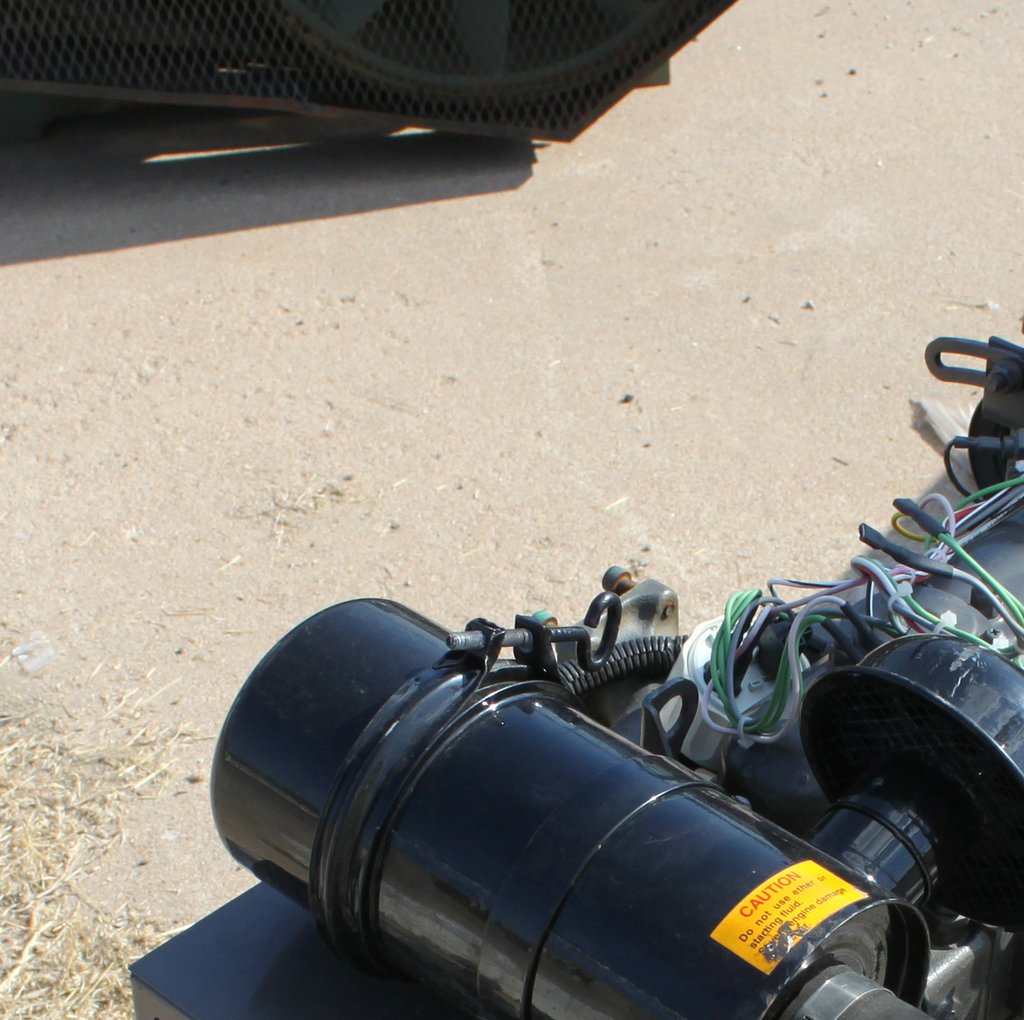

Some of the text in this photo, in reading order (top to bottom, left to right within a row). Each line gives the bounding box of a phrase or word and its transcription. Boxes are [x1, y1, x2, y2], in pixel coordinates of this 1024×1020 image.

[739, 871, 802, 918] CAUTION
[739, 929, 754, 943] Do
[756, 911, 772, 926] not
[773, 896, 790, 910] use
[792, 880, 816, 895] ether
[750, 915, 783, 949] starting
[788, 904, 816, 926] engine
